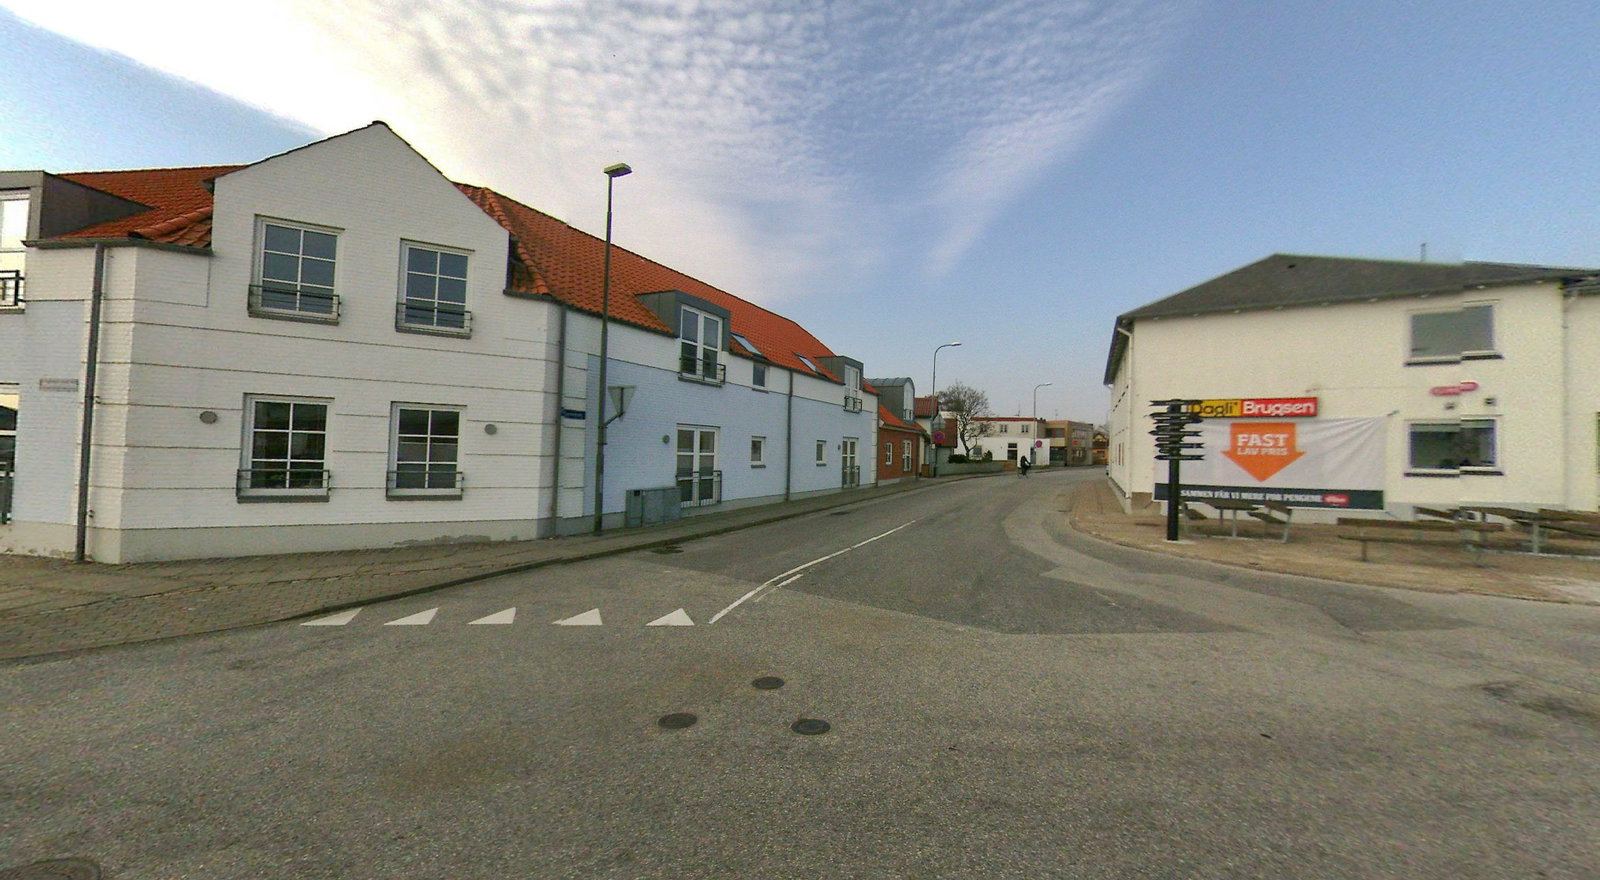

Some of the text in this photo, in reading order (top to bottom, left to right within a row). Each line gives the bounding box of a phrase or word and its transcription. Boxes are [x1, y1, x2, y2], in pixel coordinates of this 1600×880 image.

[1243, 401, 1315, 416] Brugsen
[1237, 433, 1288, 447] FAST
[1237, 447, 1288, 455] LAV PRIS
[1180, 490, 1213, 498] SAMMEN
